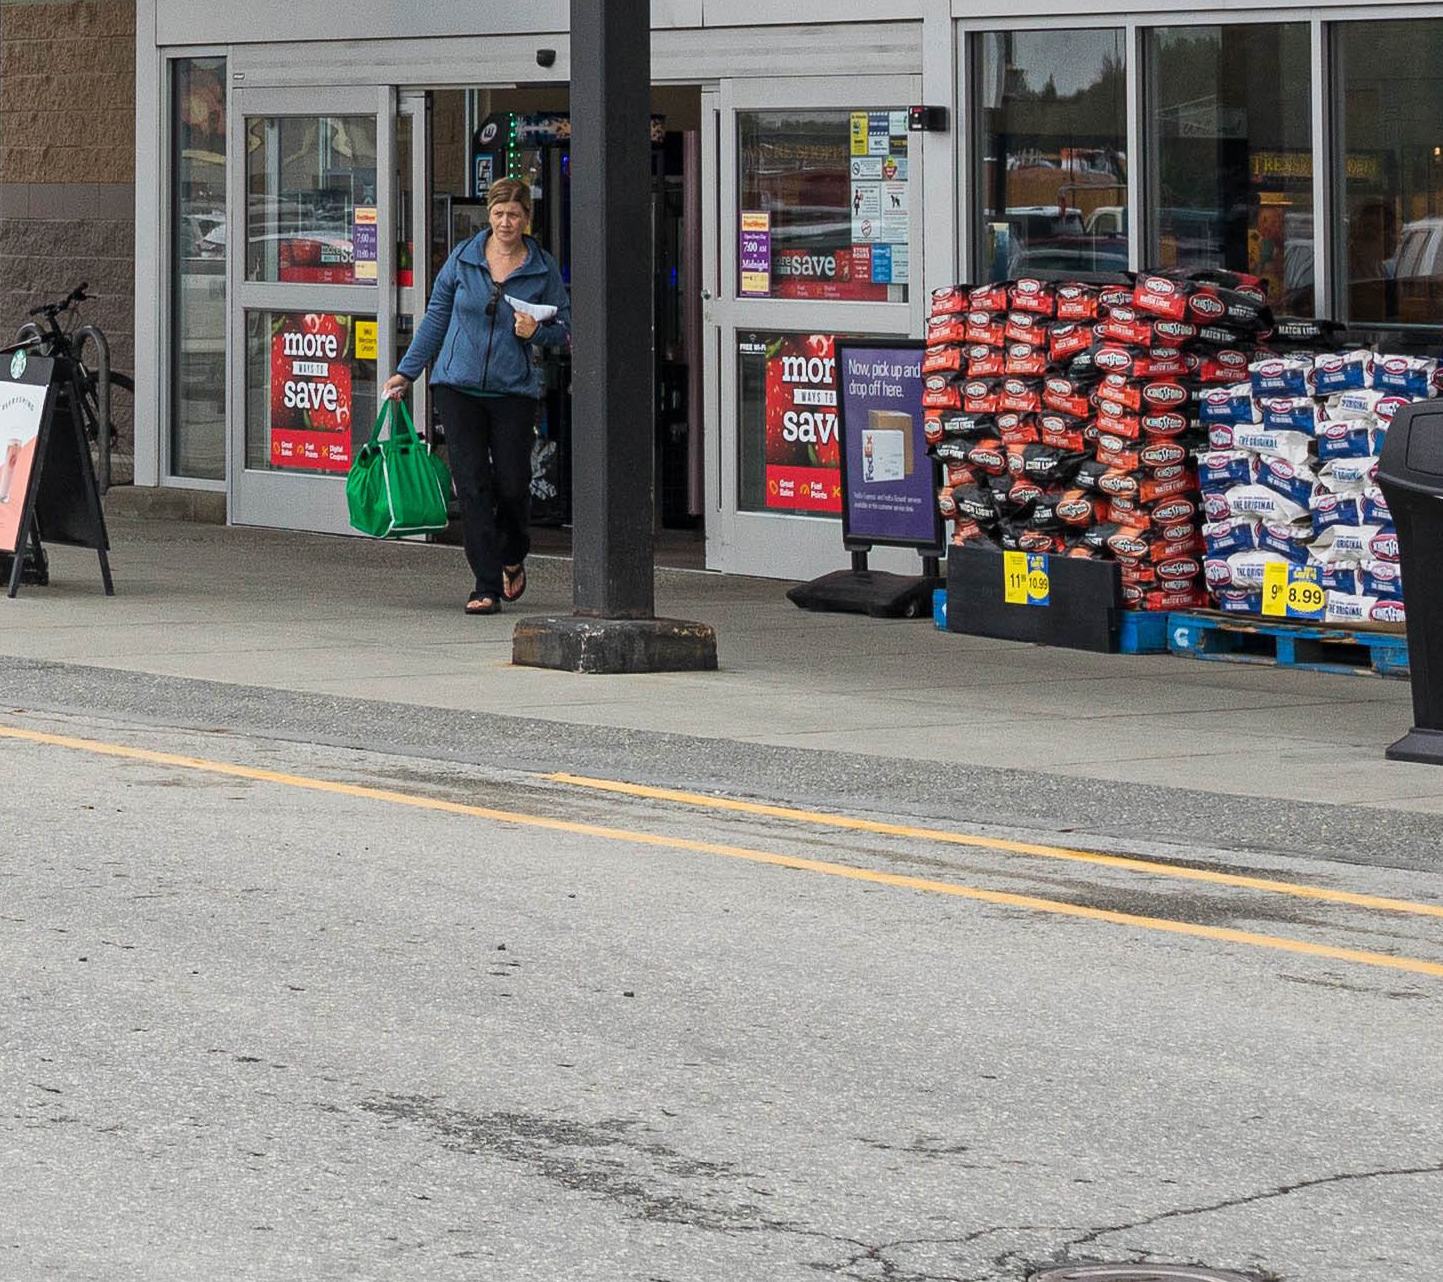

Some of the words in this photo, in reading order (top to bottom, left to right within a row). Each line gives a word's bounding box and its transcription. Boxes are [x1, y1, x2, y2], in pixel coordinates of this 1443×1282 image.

[743, 242, 758, 253] 7:00
[791, 255, 836, 276] save
[1157, 323, 1193, 335] KINGSFORD
[283, 332, 337, 358] more
[782, 355, 835, 383] mor
[848, 359, 870, 377] Now,
[872, 361, 890, 380] pick
[890, 366, 902, 381] up
[903, 362, 921, 378] and
[283, 381, 338, 410] save
[848, 380, 867, 399] drop
[869, 381, 882, 397] off
[883, 382, 904, 397] here.
[1145, 387, 1183, 402] KINGSFORD
[801, 391, 821, 403] WAYS
[824, 393, 834, 403] TO
[783, 411, 839, 444] sav
[1145, 416, 1182, 430] KINGSFORD
[1145, 448, 1182, 462] KINGSFORD
[1156, 505, 1191, 518] KINGSFORD
[1161, 563, 1196, 575] KINGSFORD
[1246, 567, 1263, 578] ORIG
[1029, 577, 1048, 590] 10.99
[1288, 588, 1322, 605] 8.99
